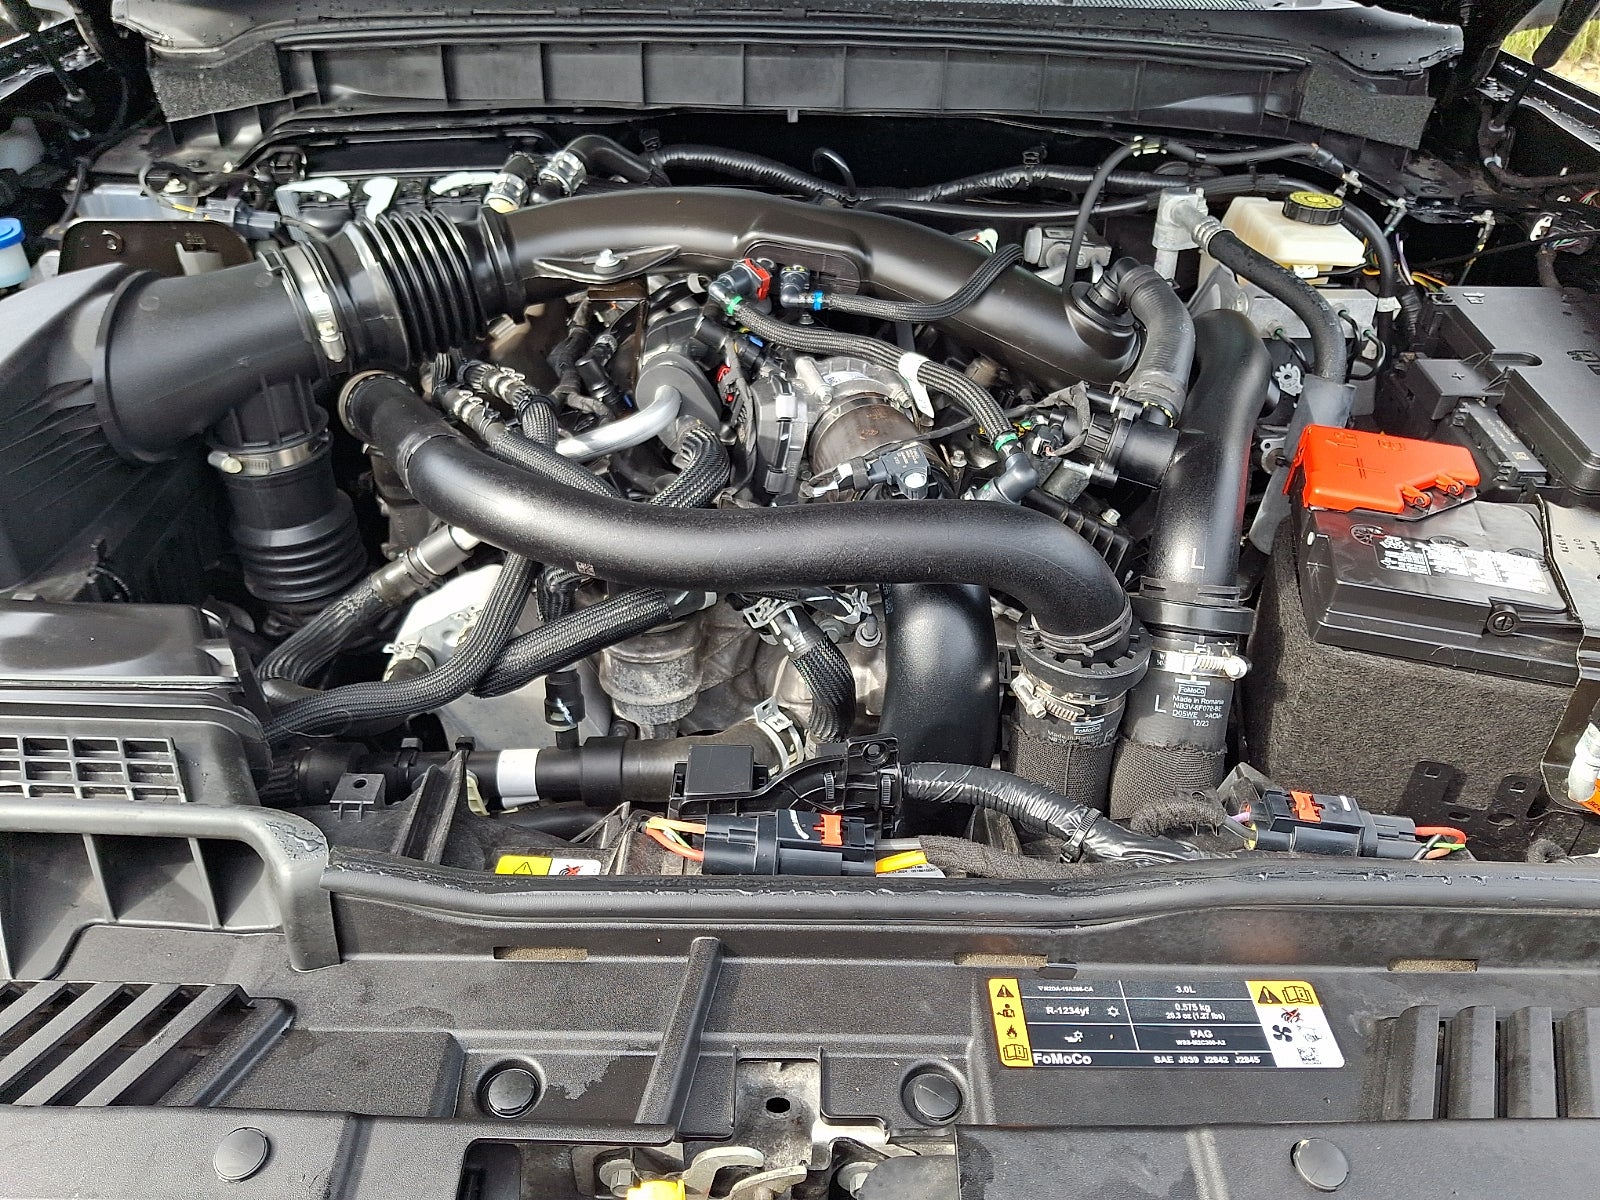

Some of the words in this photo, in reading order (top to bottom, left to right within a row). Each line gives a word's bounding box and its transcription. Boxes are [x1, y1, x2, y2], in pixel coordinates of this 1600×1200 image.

[1191, 547, 1205, 570] L
[1179, 685, 1206, 695] FoMoCo
[1154, 694, 1167, 714] L
[1172, 694, 1193, 704] Made
[1175, 985, 1197, 994] 3.0L
[1045, 1006, 1090, 1017] R-1234yf
[1174, 1002, 1198, 1012] 0.575
[1199, 1003, 1212, 1013] kg
[1189, 1029, 1214, 1039] PAG
[1032, 1052, 1093, 1065] FoMoCo
[1153, 1055, 1175, 1064] SAE
